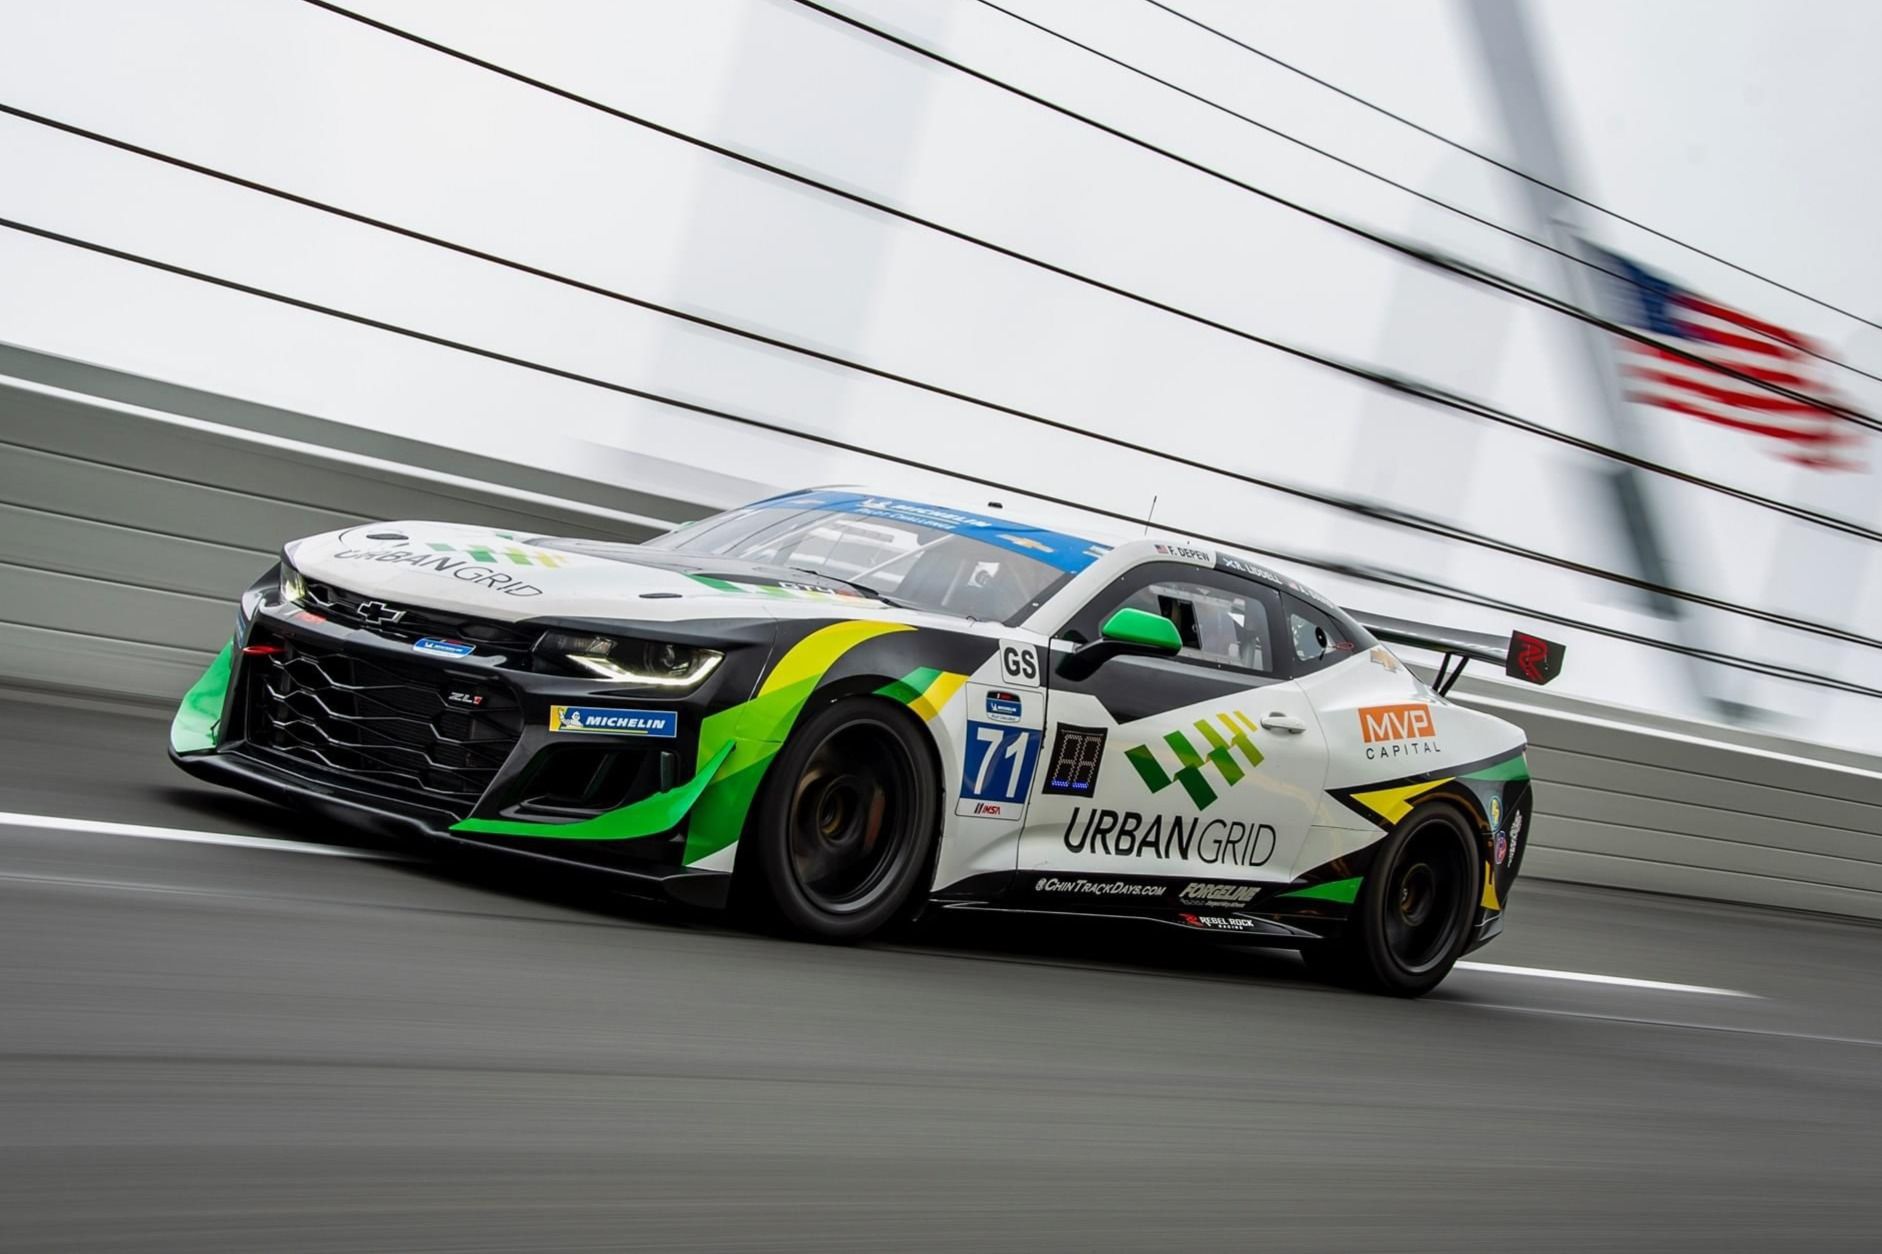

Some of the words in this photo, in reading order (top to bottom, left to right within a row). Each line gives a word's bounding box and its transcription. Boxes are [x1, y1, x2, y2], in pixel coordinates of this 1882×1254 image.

[1167, 545, 1178, 556] F.
[1179, 548, 1210, 562] DEPEW
[1003, 646, 1037, 680] GS
[448, 691, 483, 705] ZL1
[585, 715, 666, 729] MICHELIN
[1365, 709, 1429, 741] MVP
[1365, 741, 1442, 760] CAPITAL
[973, 726, 1030, 798] 71
[1179, 882, 1262, 902] FORGELINE
[1198, 916, 1229, 927] REBEL
[1227, 918, 1254, 927] ROCK
